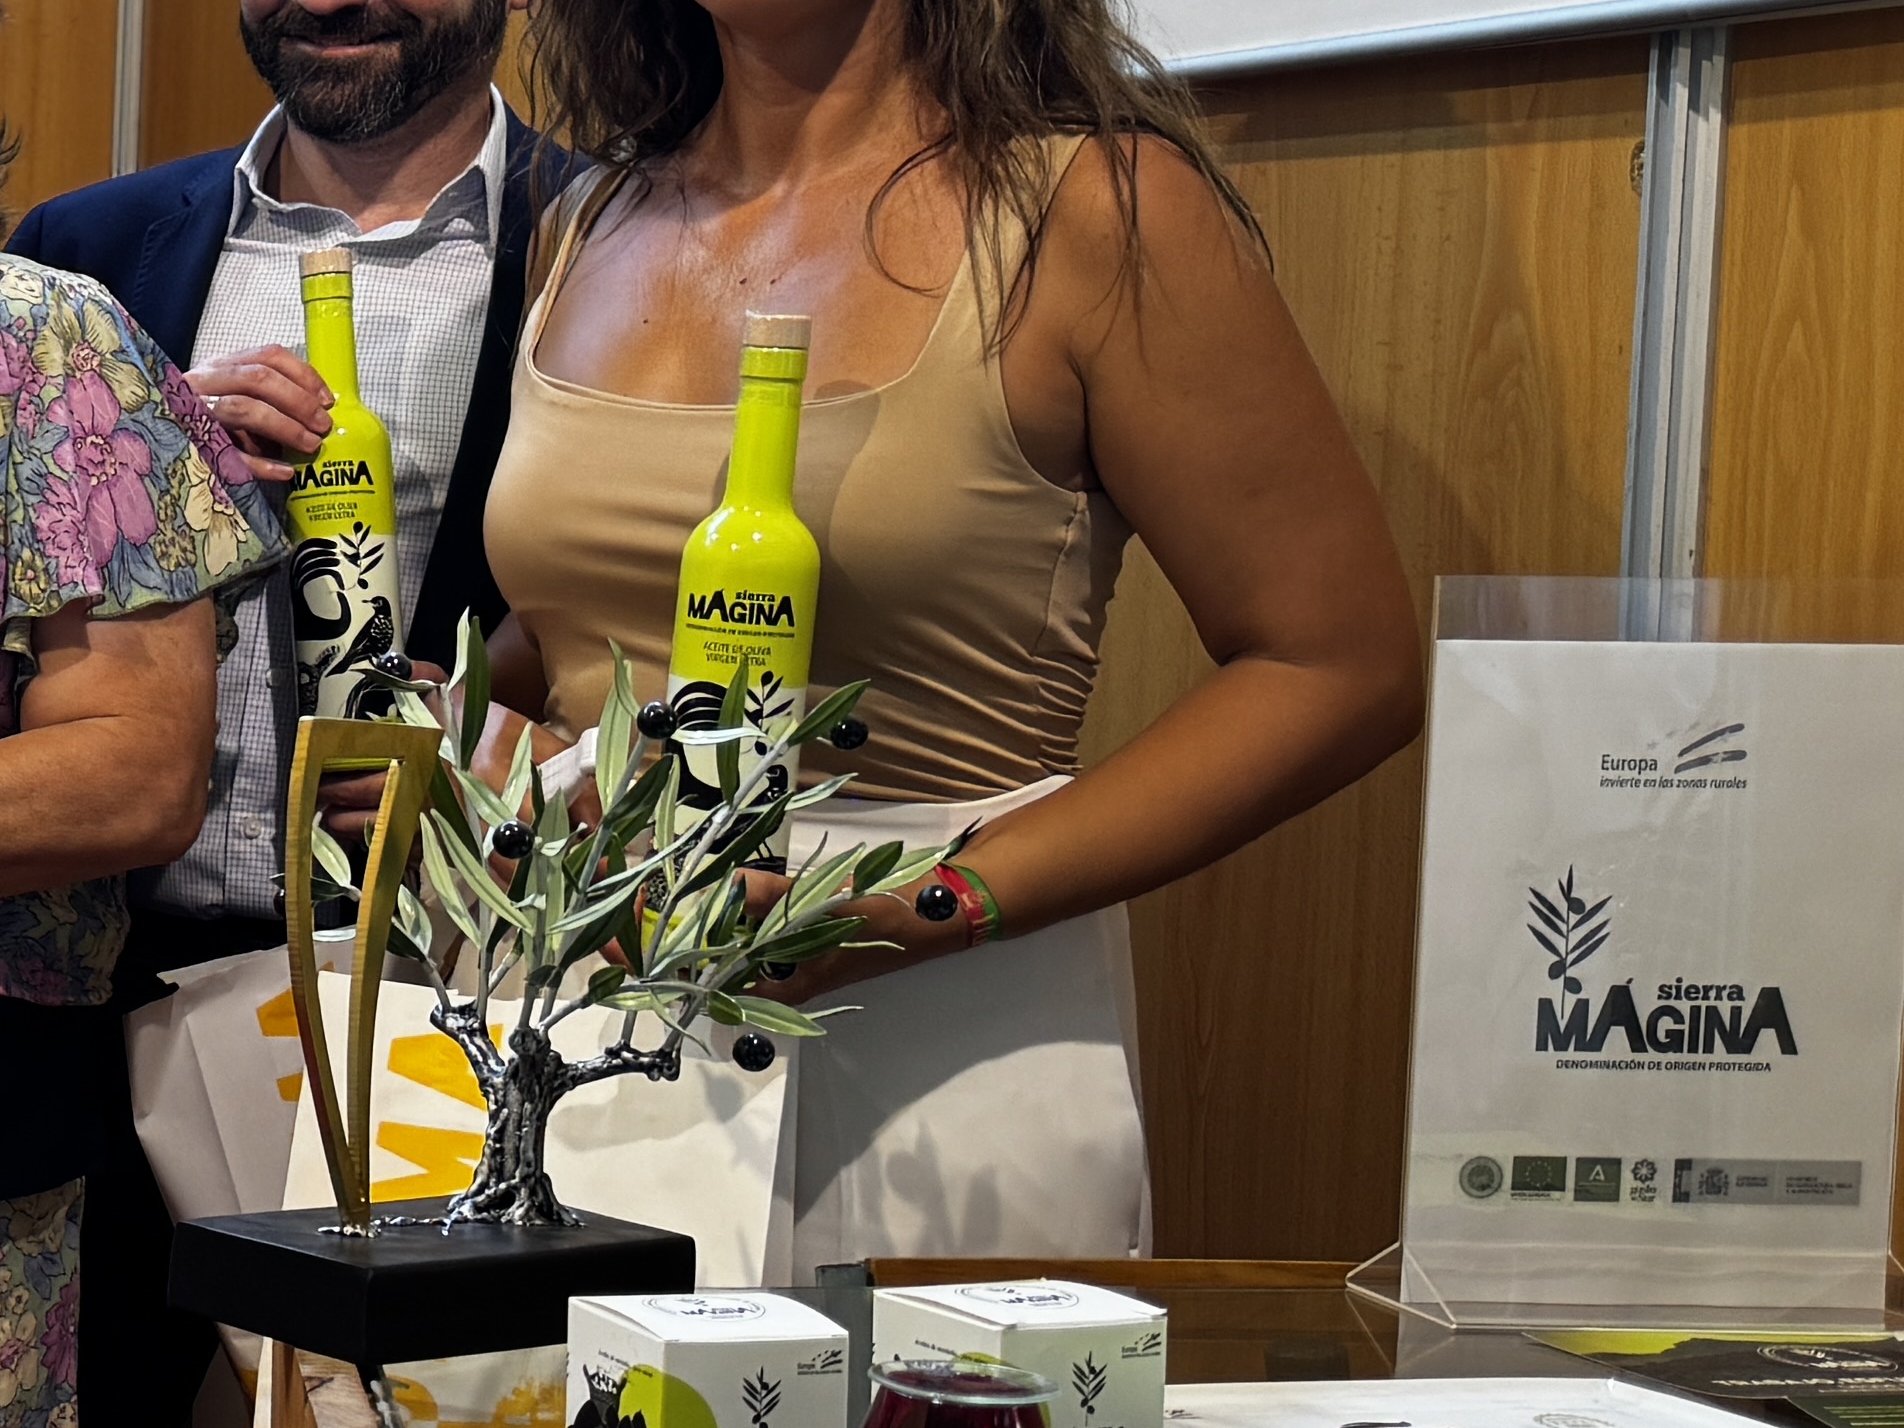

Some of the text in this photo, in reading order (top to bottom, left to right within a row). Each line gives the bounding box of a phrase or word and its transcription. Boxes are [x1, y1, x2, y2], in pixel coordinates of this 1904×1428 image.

[1601, 753, 1658, 775] Europa
[1600, 776, 1641, 788] invierte
[1658, 775, 1674, 788] las
[1675, 778, 1708, 789] zonas
[1710, 775, 1748, 789] rurales
[1657, 976, 1746, 1002] sierra
[1535, 977, 1799, 1056] MÁGINA
[1555, 1059, 1772, 1072] DENOMINACIÓN DE ORIGEN PROTEGIDA
